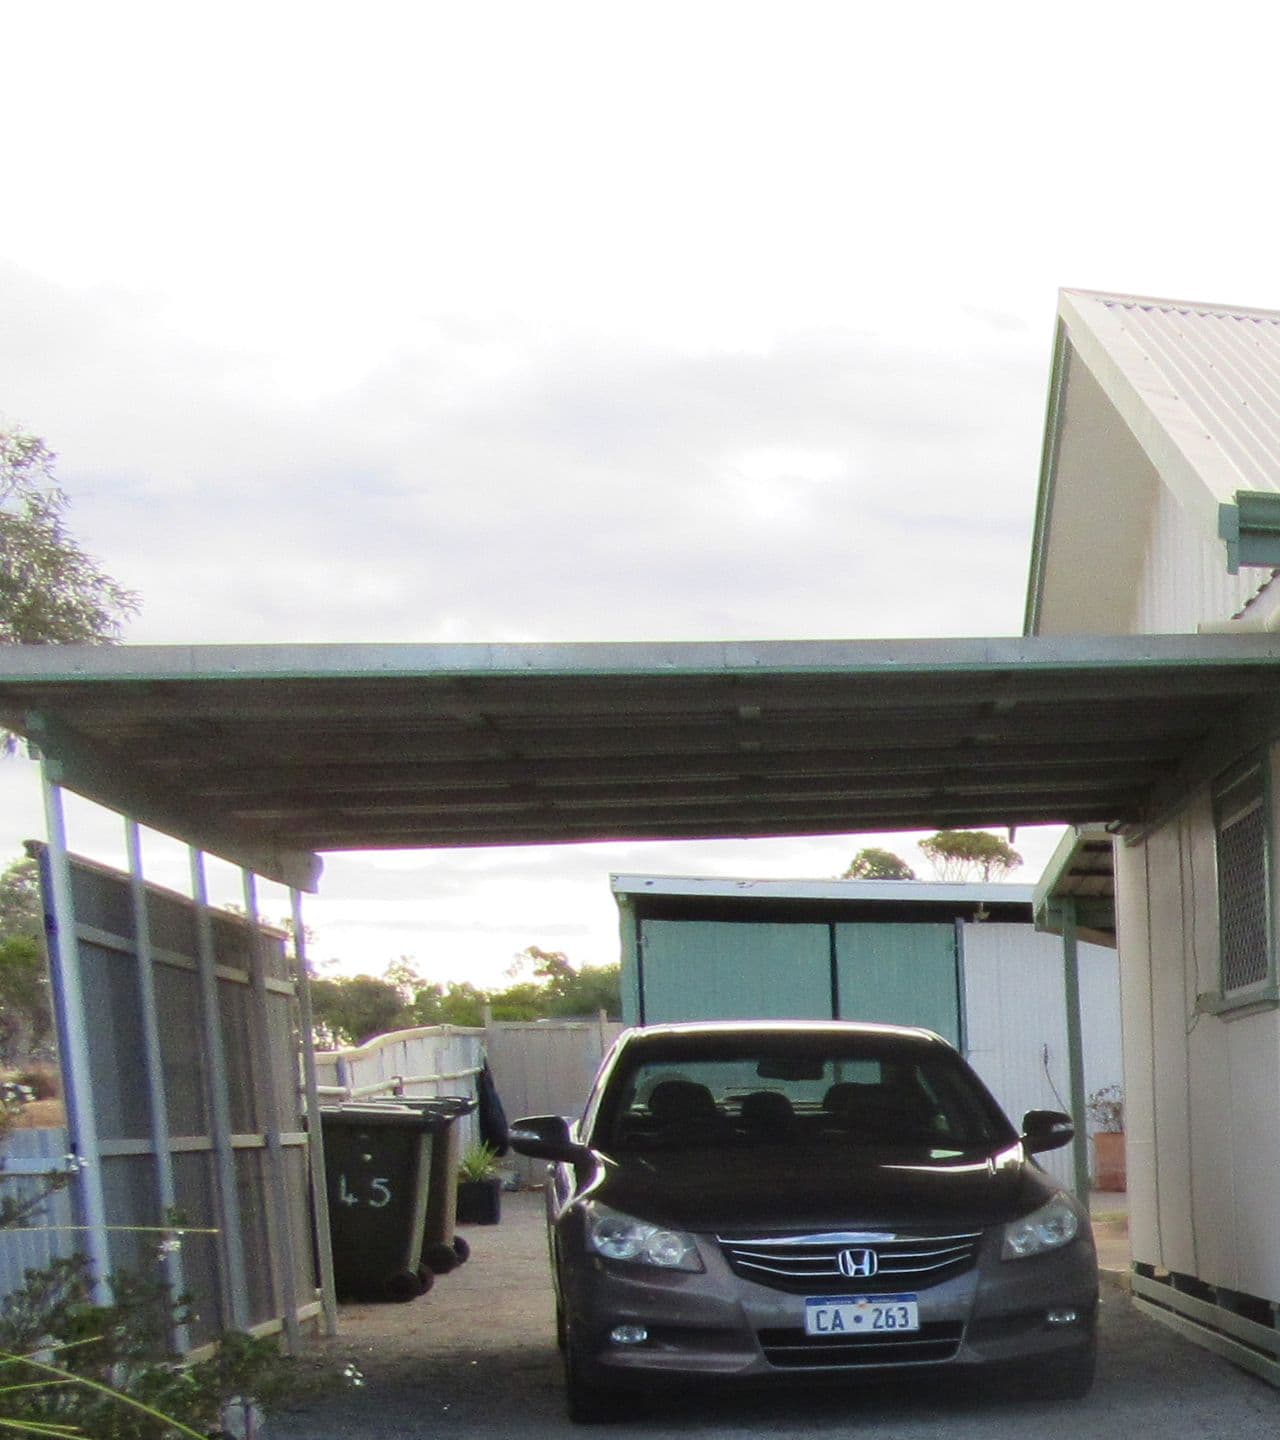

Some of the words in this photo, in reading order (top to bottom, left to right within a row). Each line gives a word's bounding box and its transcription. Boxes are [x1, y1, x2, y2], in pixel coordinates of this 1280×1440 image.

[340, 1174, 391, 1208] 45
[816, 1308, 845, 1332] CA
[872, 1306, 910, 1330] 263
